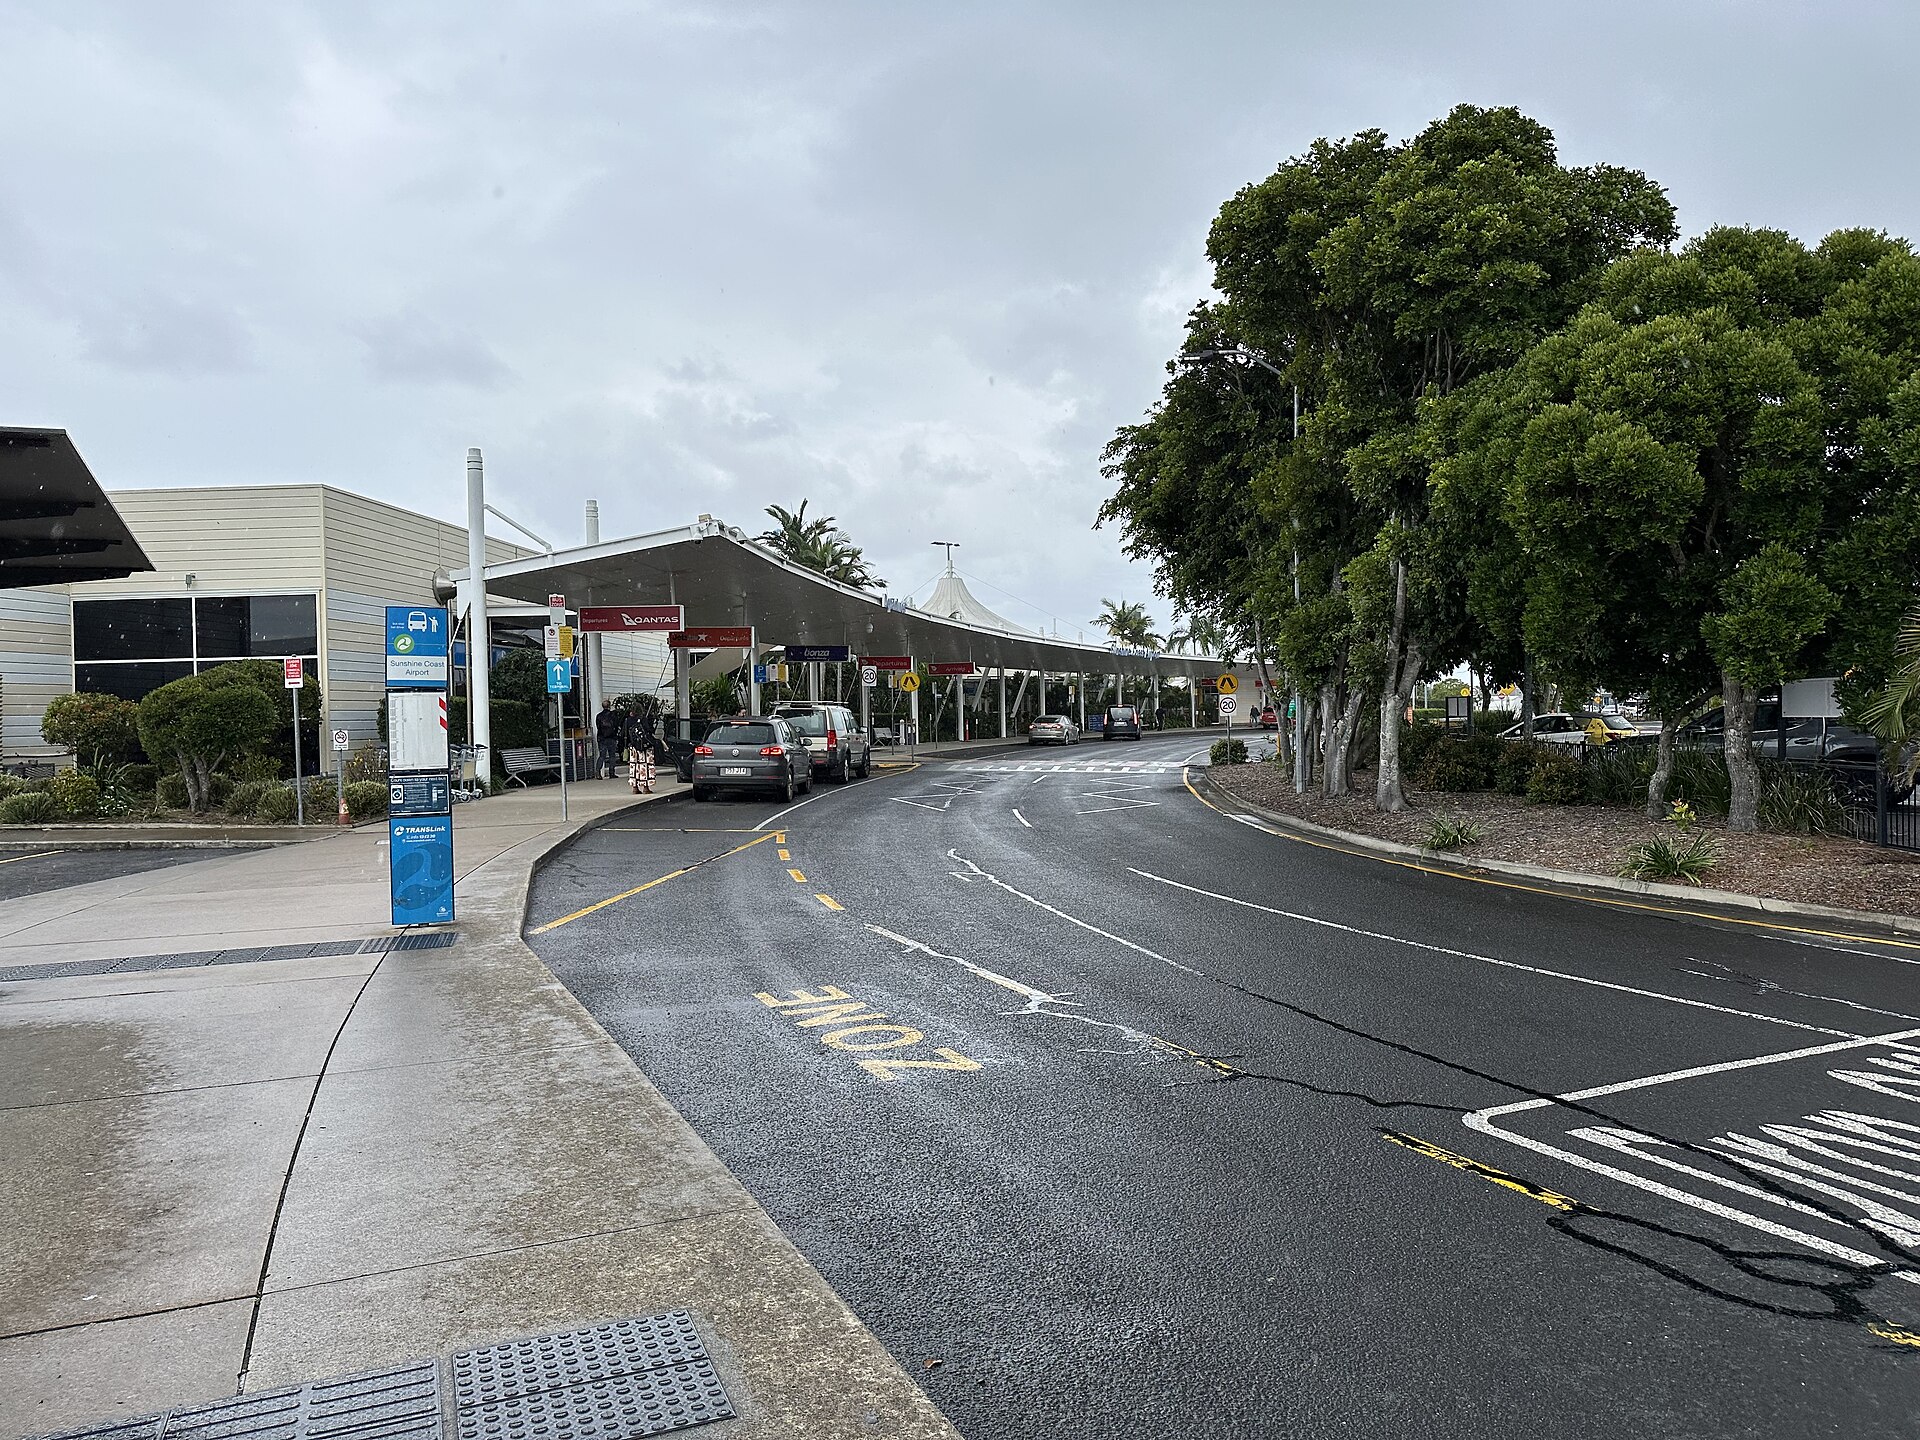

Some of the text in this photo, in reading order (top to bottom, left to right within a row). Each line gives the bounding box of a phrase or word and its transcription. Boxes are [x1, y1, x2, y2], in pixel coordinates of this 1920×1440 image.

[405, 669, 429, 677] Airport
[757, 665, 764, 673] P
[864, 672, 875, 680] 20
[1222, 701, 1234, 710] 20
[405, 826, 446, 834] TRANSLink
[752, 984, 985, 1082] ZONE
